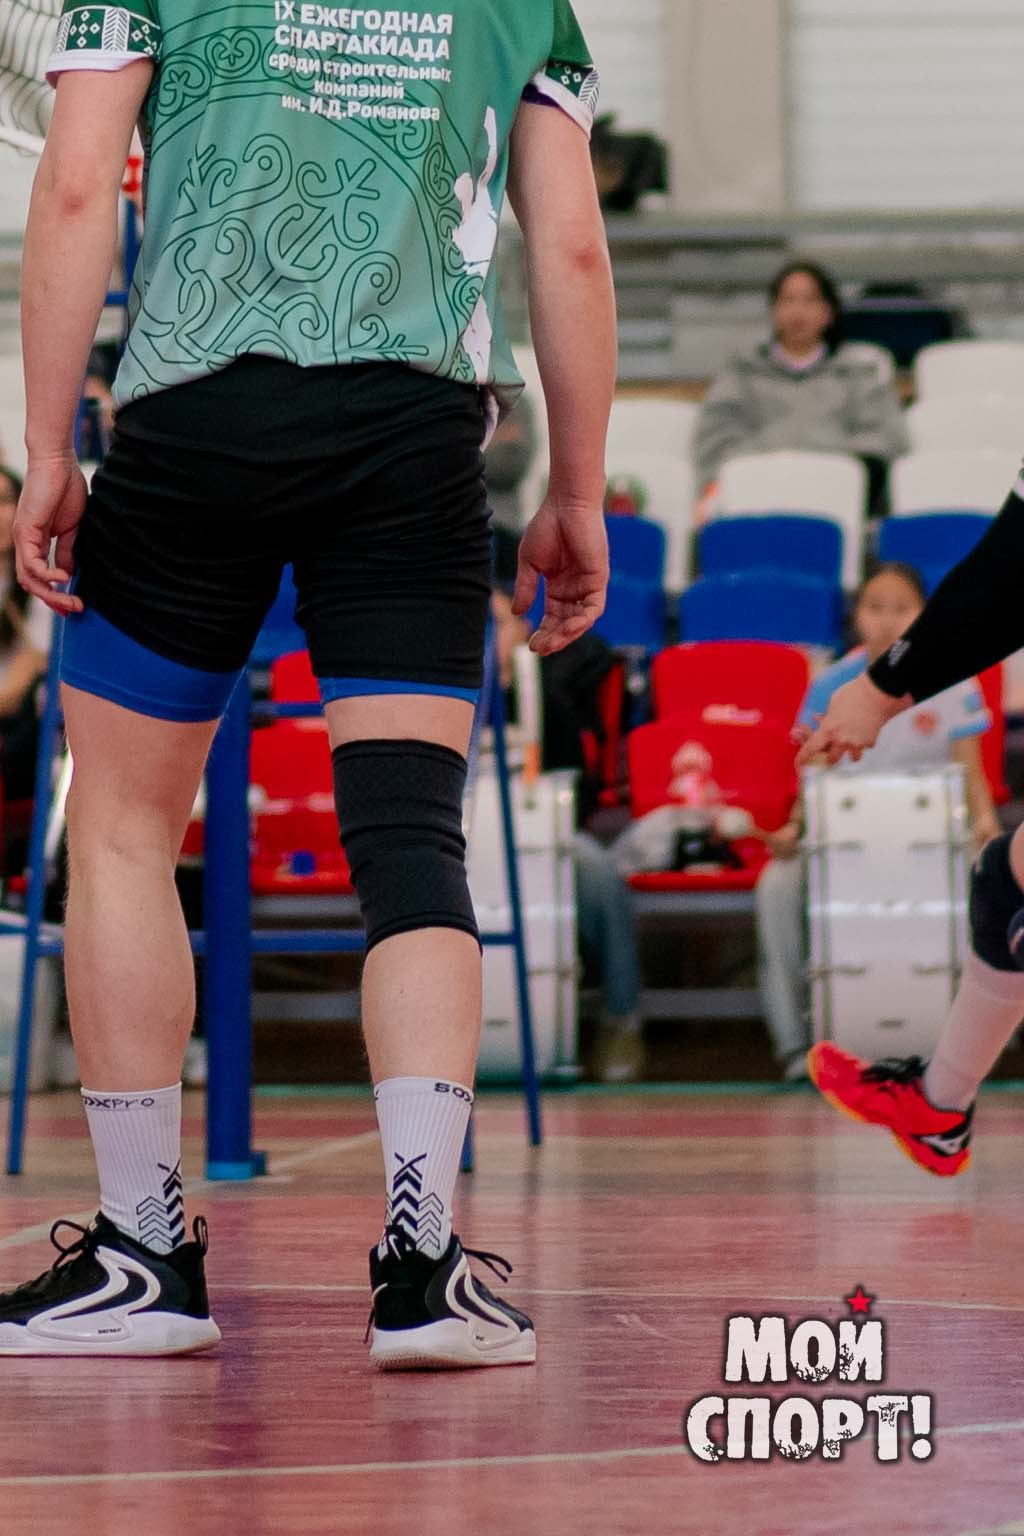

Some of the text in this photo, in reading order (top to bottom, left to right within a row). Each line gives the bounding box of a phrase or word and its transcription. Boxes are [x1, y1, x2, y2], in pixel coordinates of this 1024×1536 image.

[274, 0, 454, 36] IX ЕЖЕГОДНАЯ
[274, 24, 451, 62] СПАРТАКИАДА
[268, 52, 452, 83] среди строительных
[314, 79, 405, 100] компаний
[309, 96, 441, 121] И.Д.Романова
